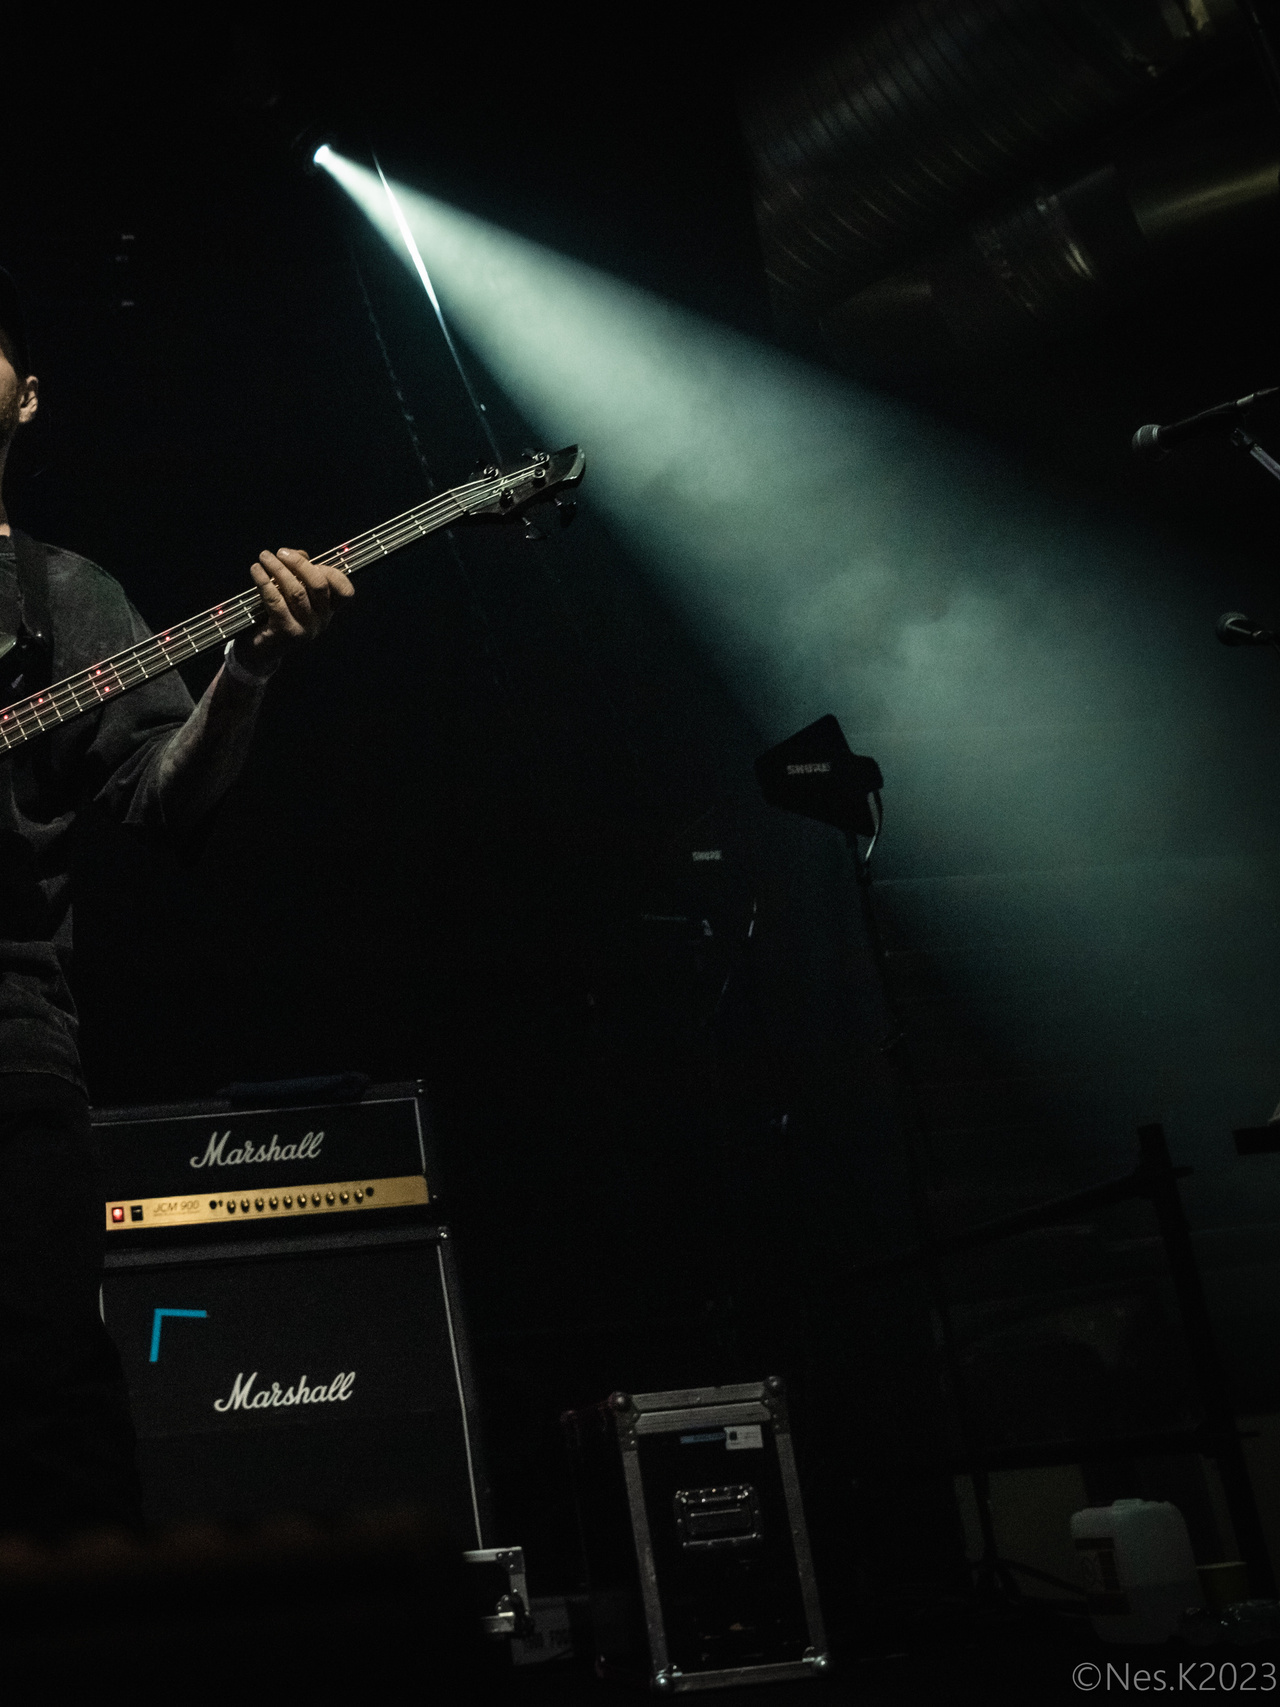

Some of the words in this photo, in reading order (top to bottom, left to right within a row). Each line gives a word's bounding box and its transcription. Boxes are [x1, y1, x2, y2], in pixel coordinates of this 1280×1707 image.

[189, 1129, 325, 1168] Marshall
[153, 1202, 178, 1214] JCM
[180, 1200, 200, 1211] 900
[213, 1370, 356, 1413] Marshall
